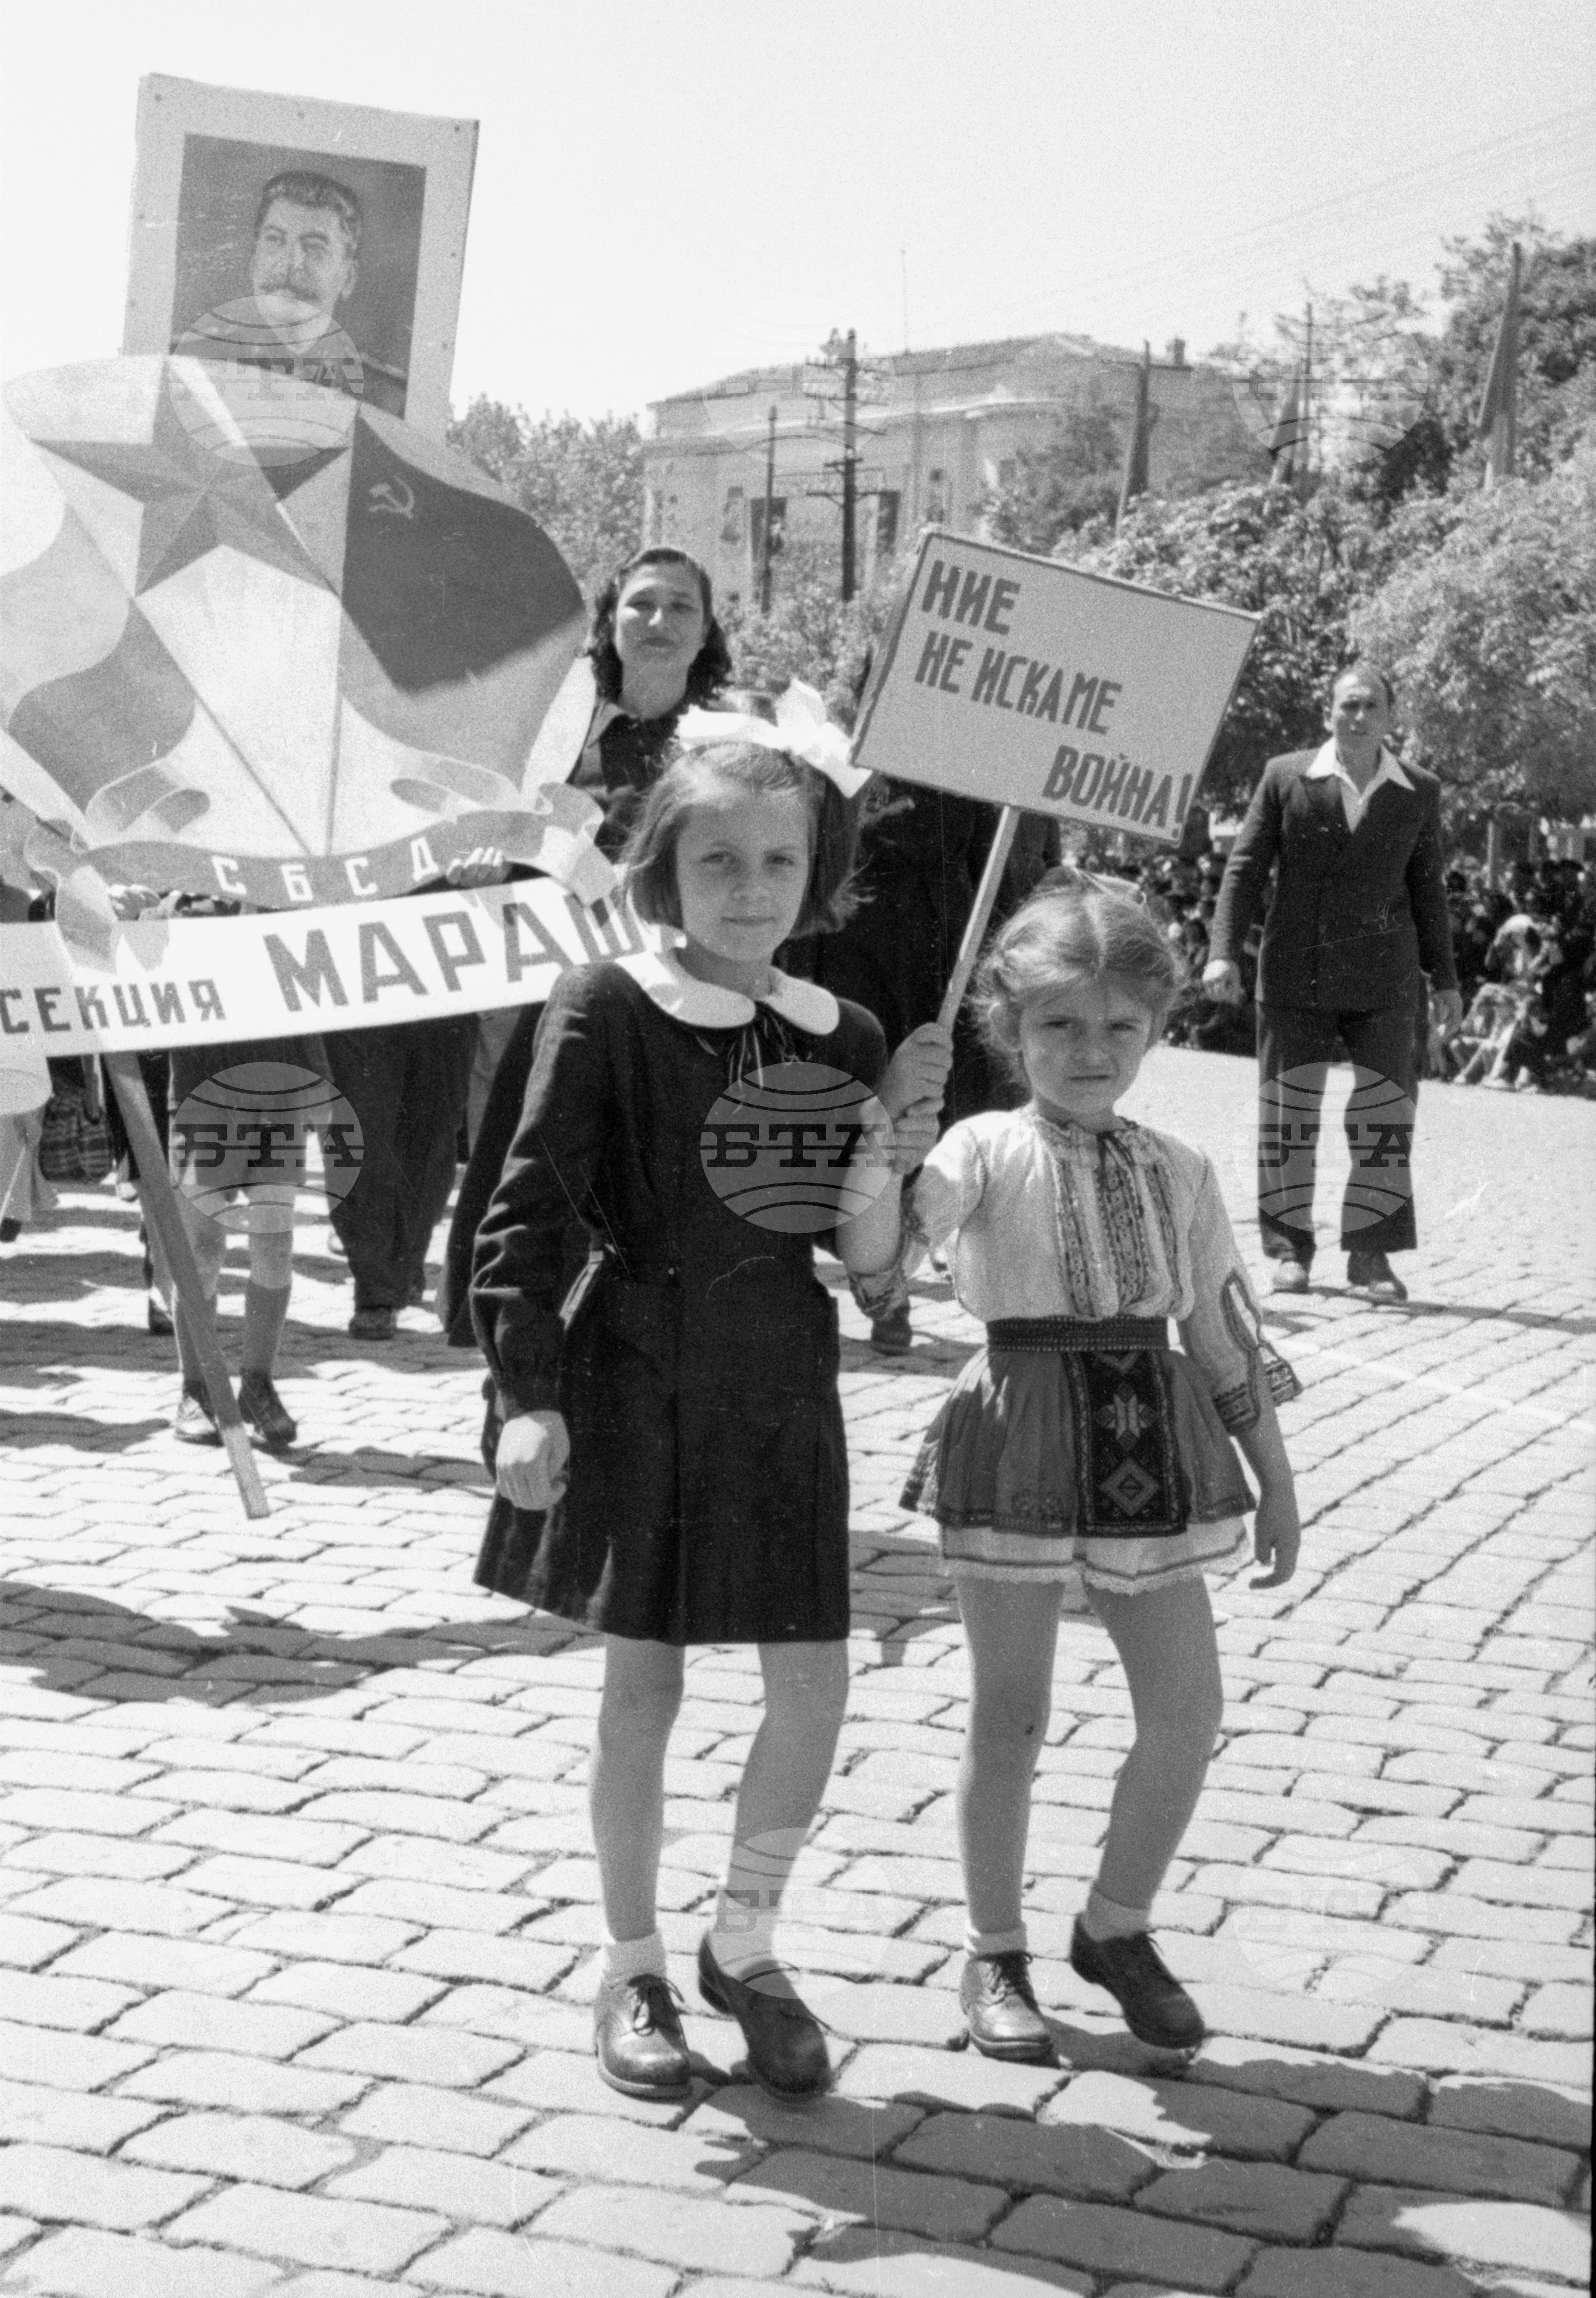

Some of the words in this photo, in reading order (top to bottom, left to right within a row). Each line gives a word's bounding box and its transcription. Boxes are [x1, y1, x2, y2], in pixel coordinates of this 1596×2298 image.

[922, 560, 1021, 634] НИЕ
[915, 631, 973, 694] НЕ
[971, 647, 1123, 735] ИСКАМЕ
[1042, 745, 1193, 839] ВОЙНА!
[0, 978, 227, 1034] СЕКЦИЯ
[263, 885, 647, 1012] МАРАШ
